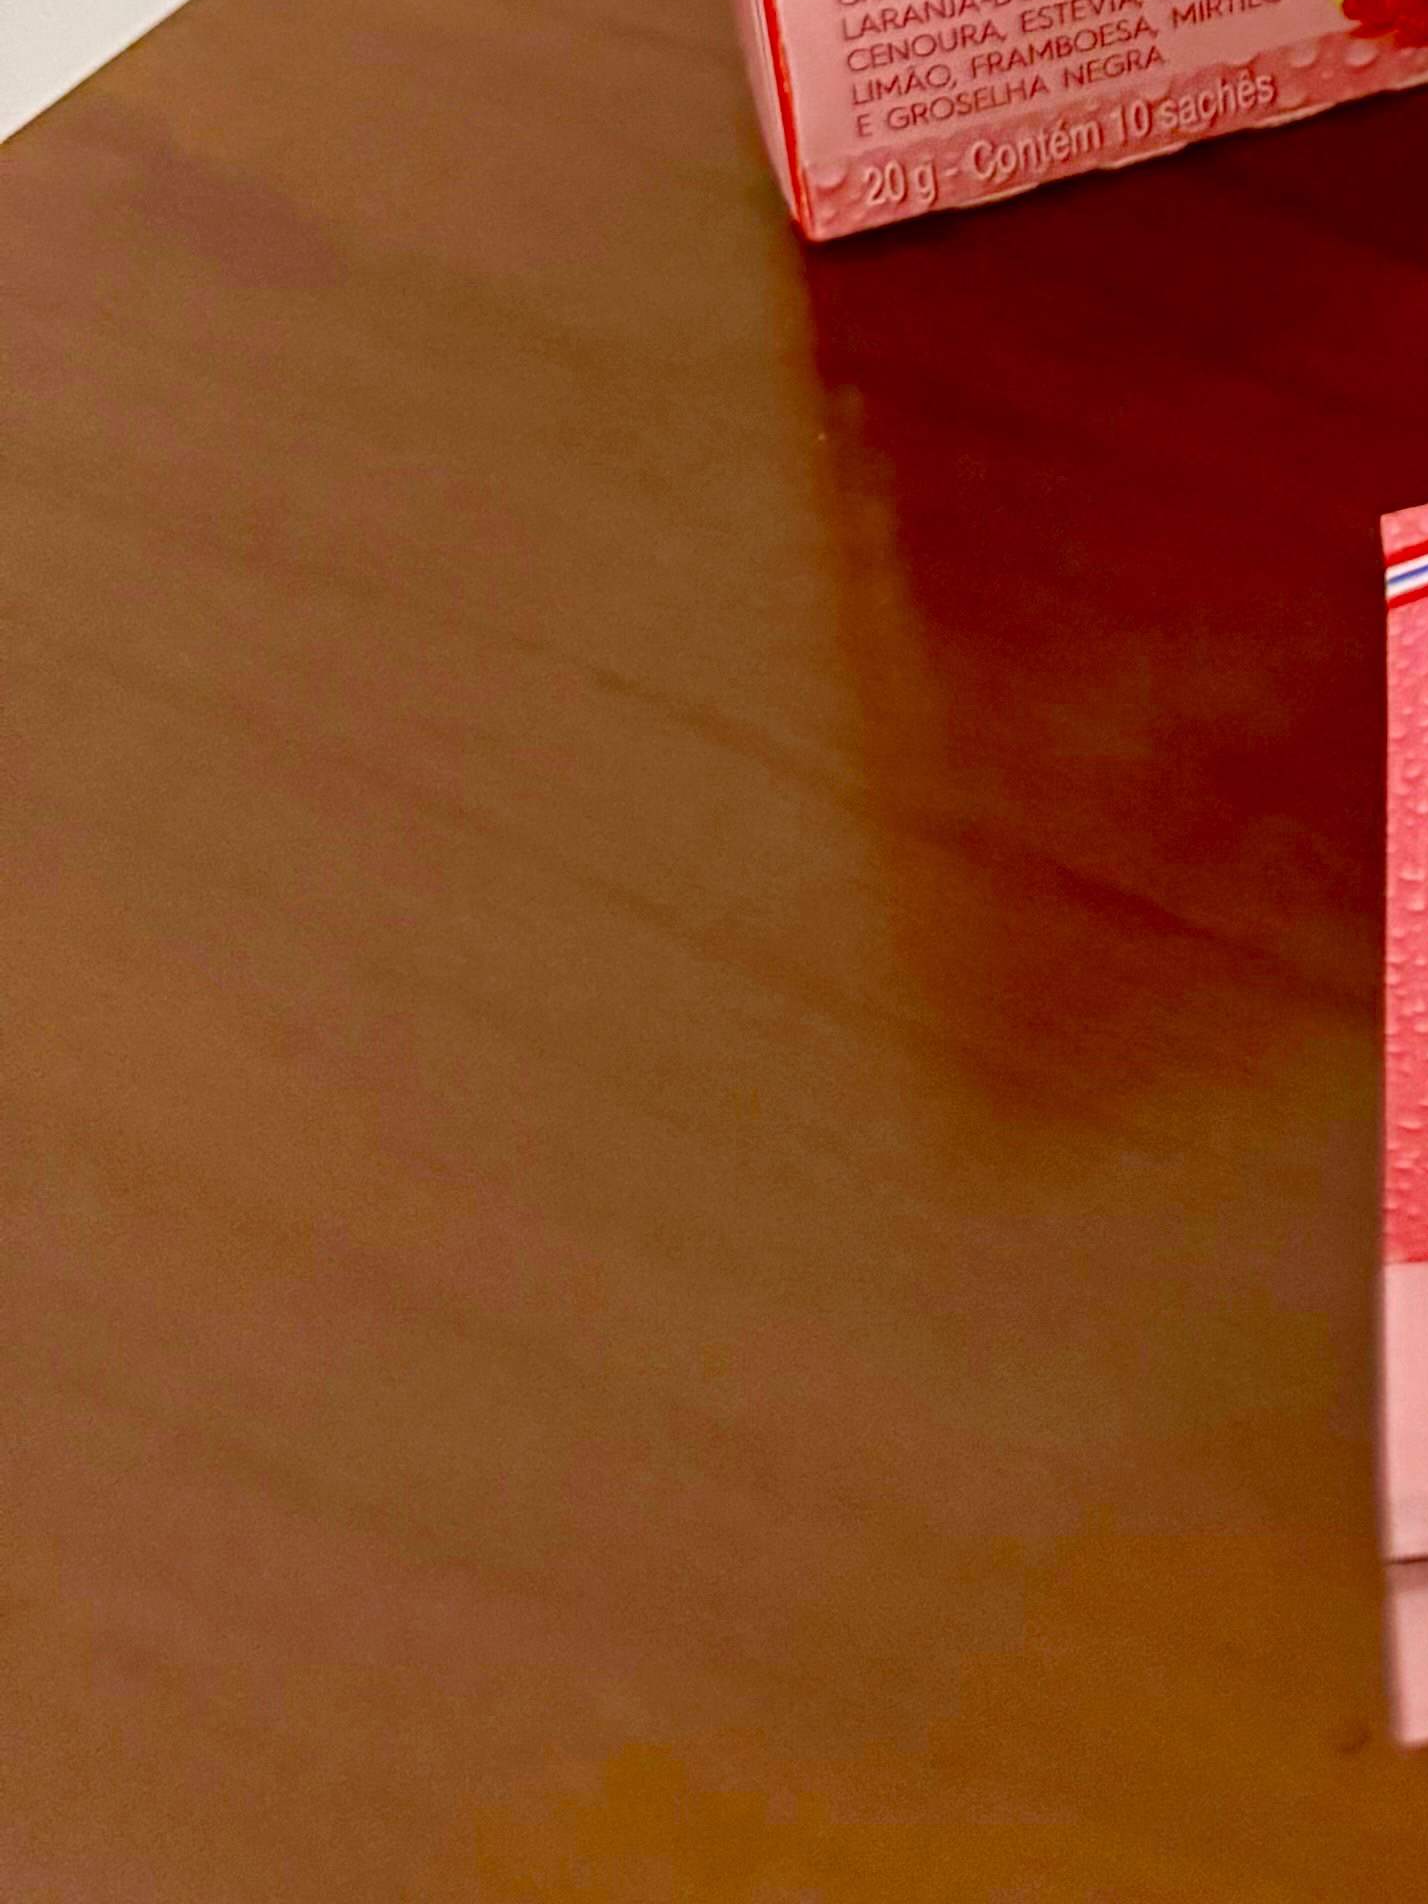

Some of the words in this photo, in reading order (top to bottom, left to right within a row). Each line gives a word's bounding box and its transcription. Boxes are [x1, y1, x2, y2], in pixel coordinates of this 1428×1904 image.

[845, 18, 1008, 73] CENOURA,
[851, 60, 958, 106] LIMÃO,
[970, 15, 1160, 81] FRAMBOESA,
[855, 112, 875, 139] E
[885, 75, 1049, 133] GROSELHA
[1062, 44, 1167, 89] NEGRA
[862, 162, 909, 206] 20
[913, 158, 940, 206] g
[969, 117, 1101, 182] Contém
[1110, 98, 1151, 139] 10
[1157, 68, 1278, 129] sachês
